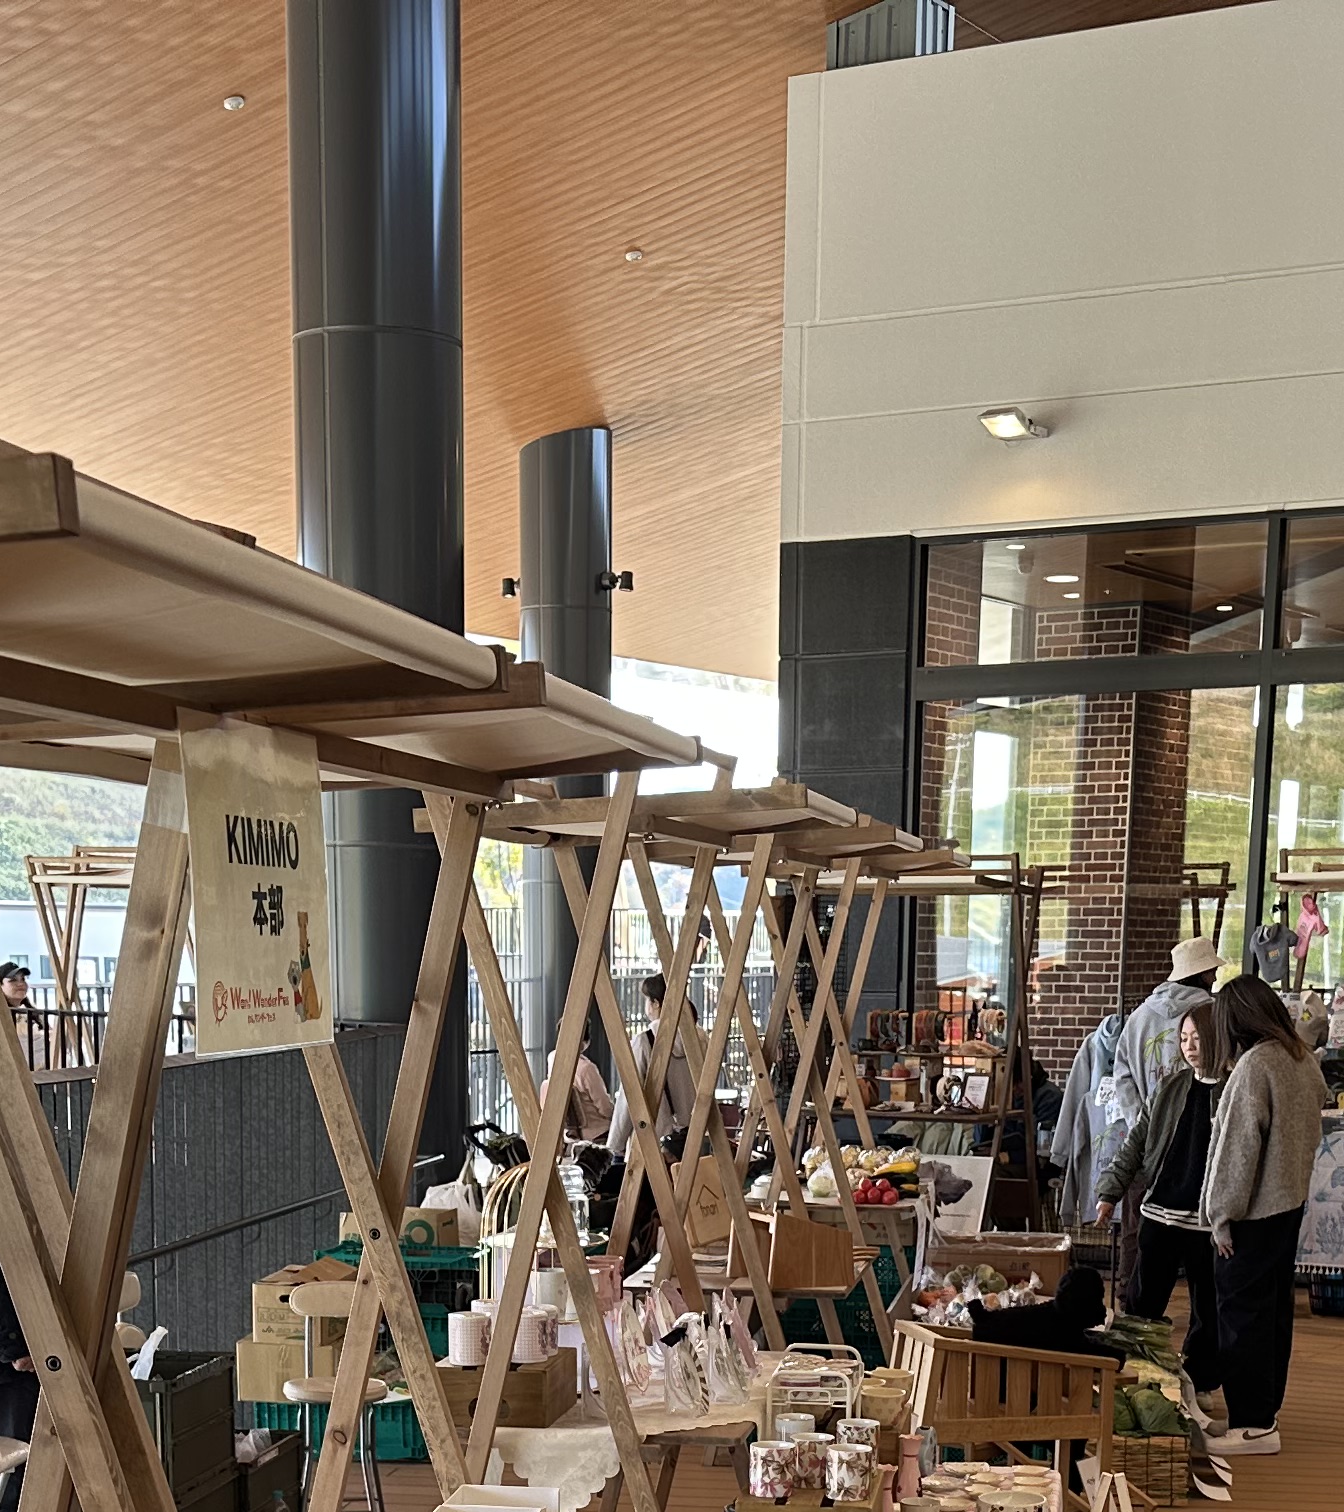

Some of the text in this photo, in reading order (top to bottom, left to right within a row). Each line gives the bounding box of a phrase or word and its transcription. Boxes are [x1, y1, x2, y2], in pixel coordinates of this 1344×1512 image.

[224, 813, 300, 870] KIMIMO
[251, 882, 285, 937] 本部
[229, 986, 290, 1010] Wan! Wonder Fes
